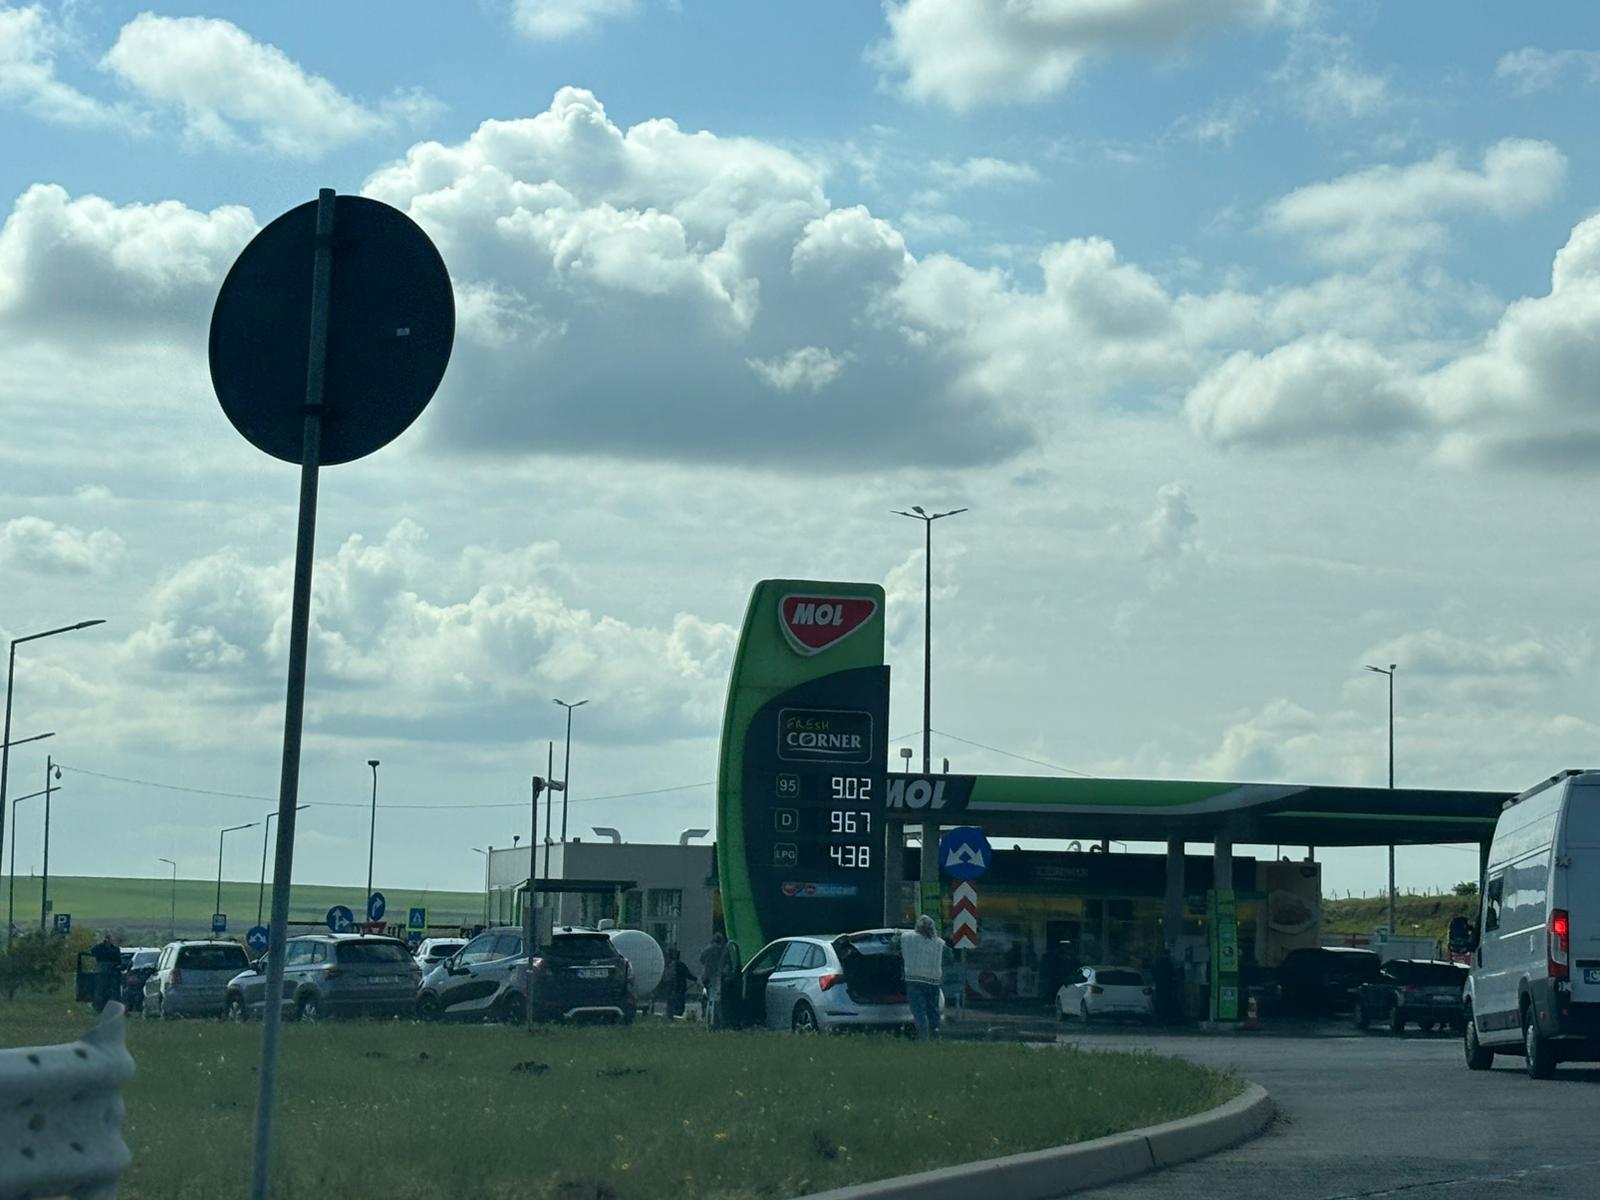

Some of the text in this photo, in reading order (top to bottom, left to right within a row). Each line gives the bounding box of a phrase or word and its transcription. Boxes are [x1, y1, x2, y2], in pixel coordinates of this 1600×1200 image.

[791, 603, 844, 627] MOL
[786, 717, 830, 730] FRESH
[786, 732, 863, 750] CORNER
[780, 779, 797, 792] 95
[782, 813, 792, 826] D
[776, 849, 796, 860] LPG
